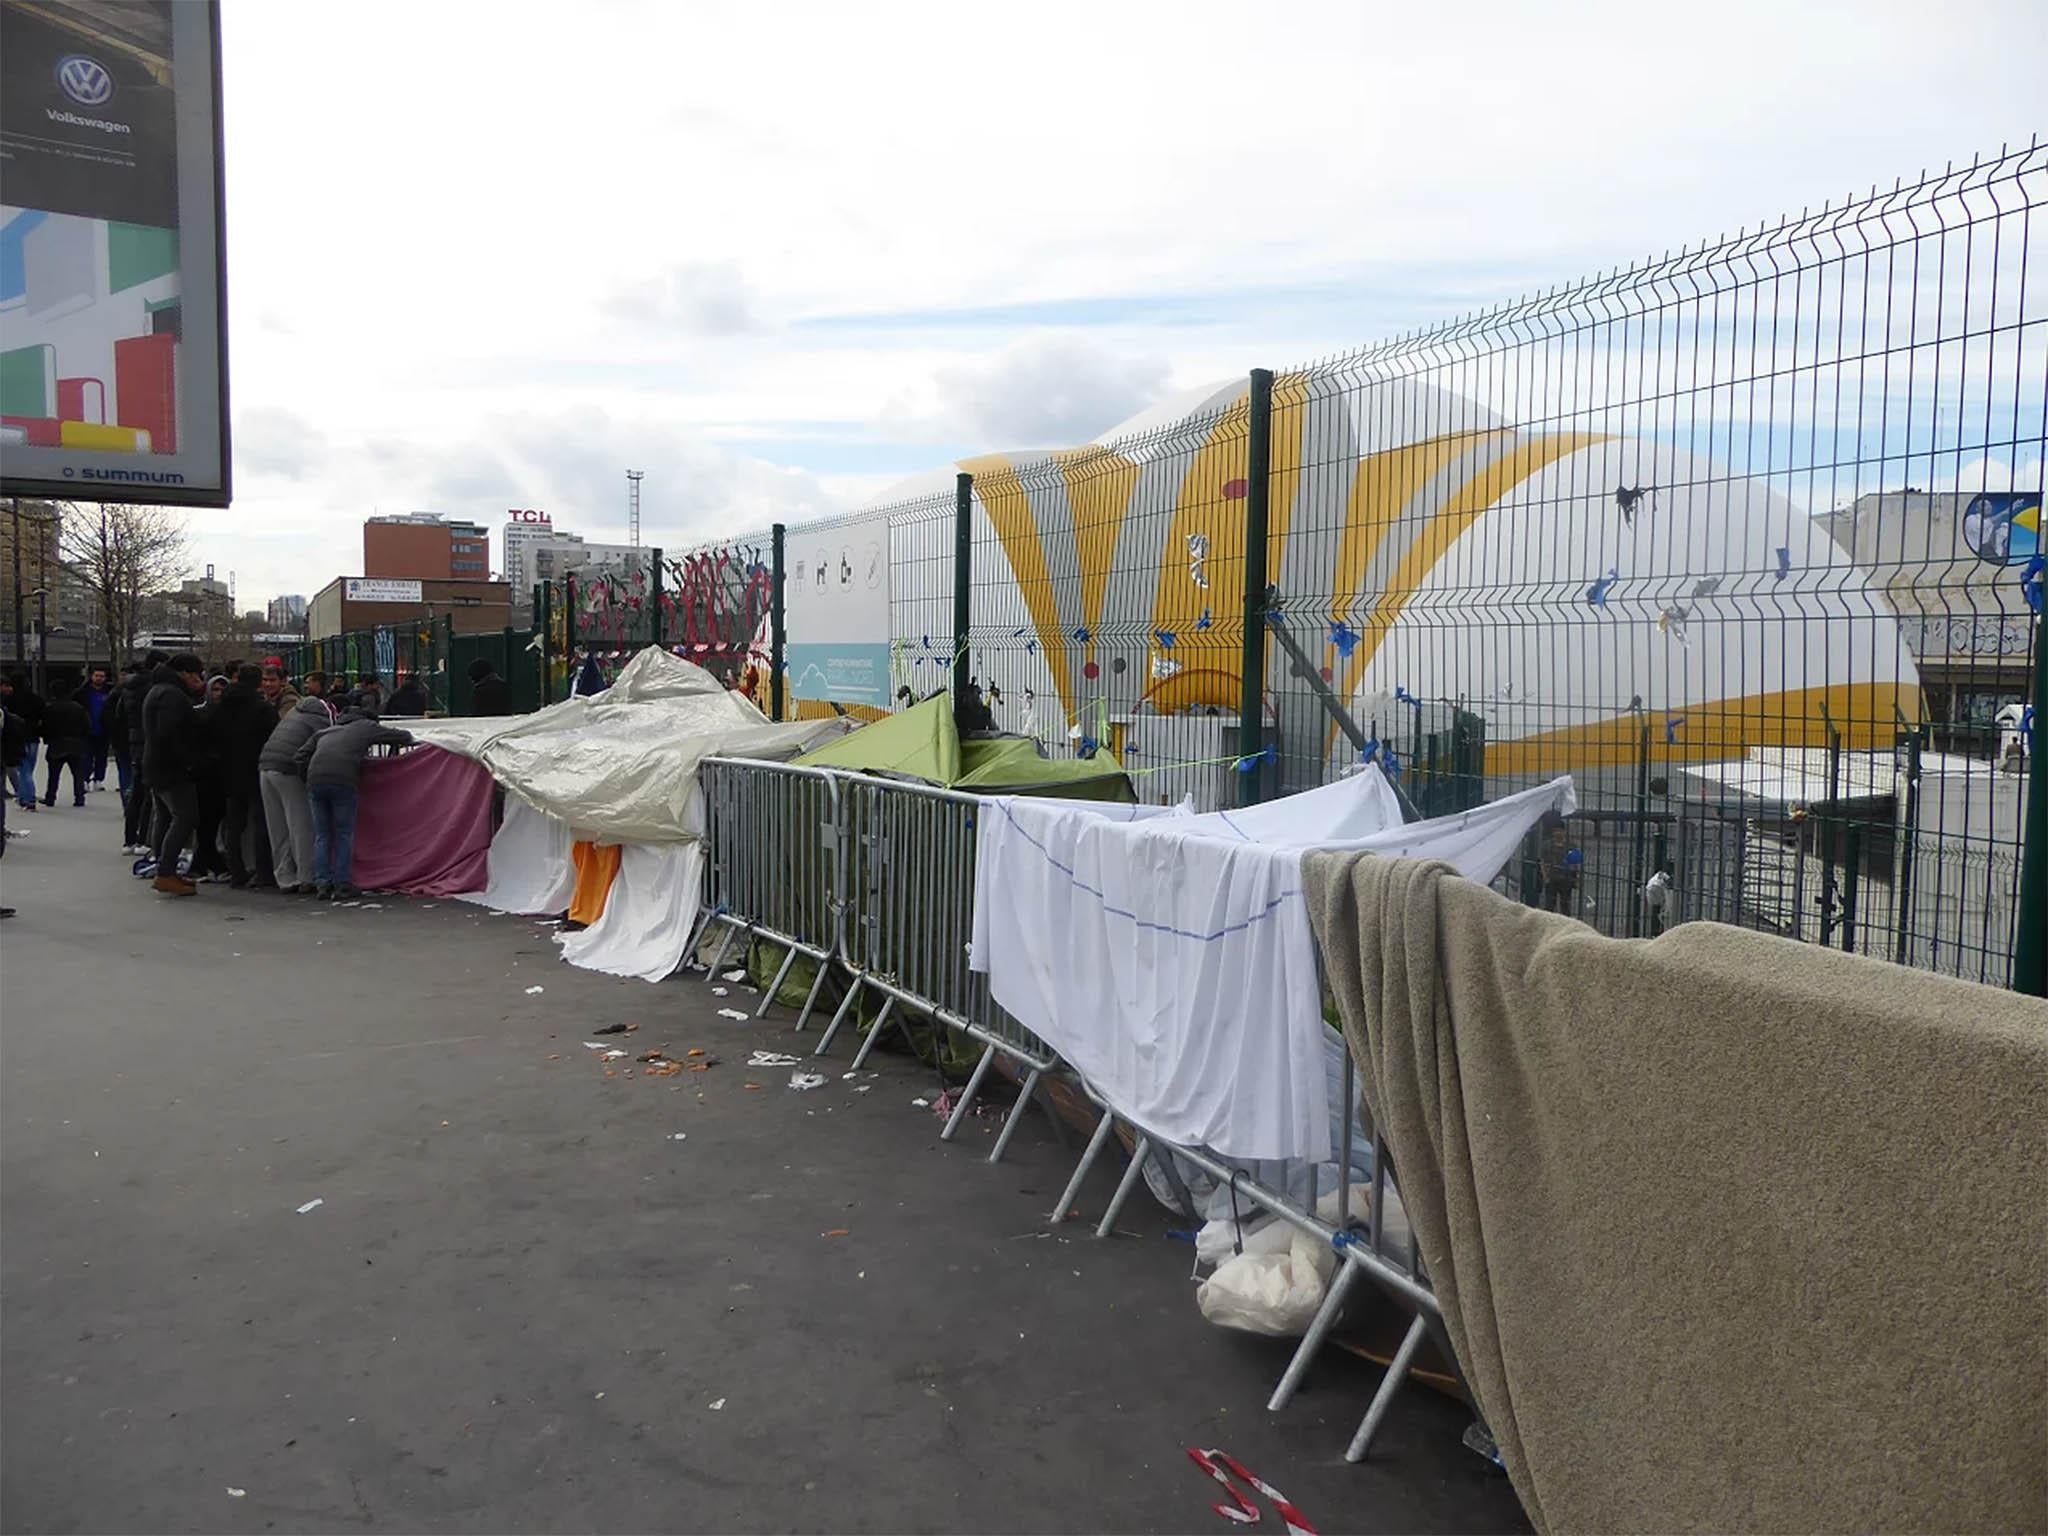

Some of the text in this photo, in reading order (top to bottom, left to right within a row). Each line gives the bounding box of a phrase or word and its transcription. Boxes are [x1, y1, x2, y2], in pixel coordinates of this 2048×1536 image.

[46, 109, 131, 133] Volkswagen
[81, 468, 184, 484] summum
[508, 509, 552, 523] TCL
